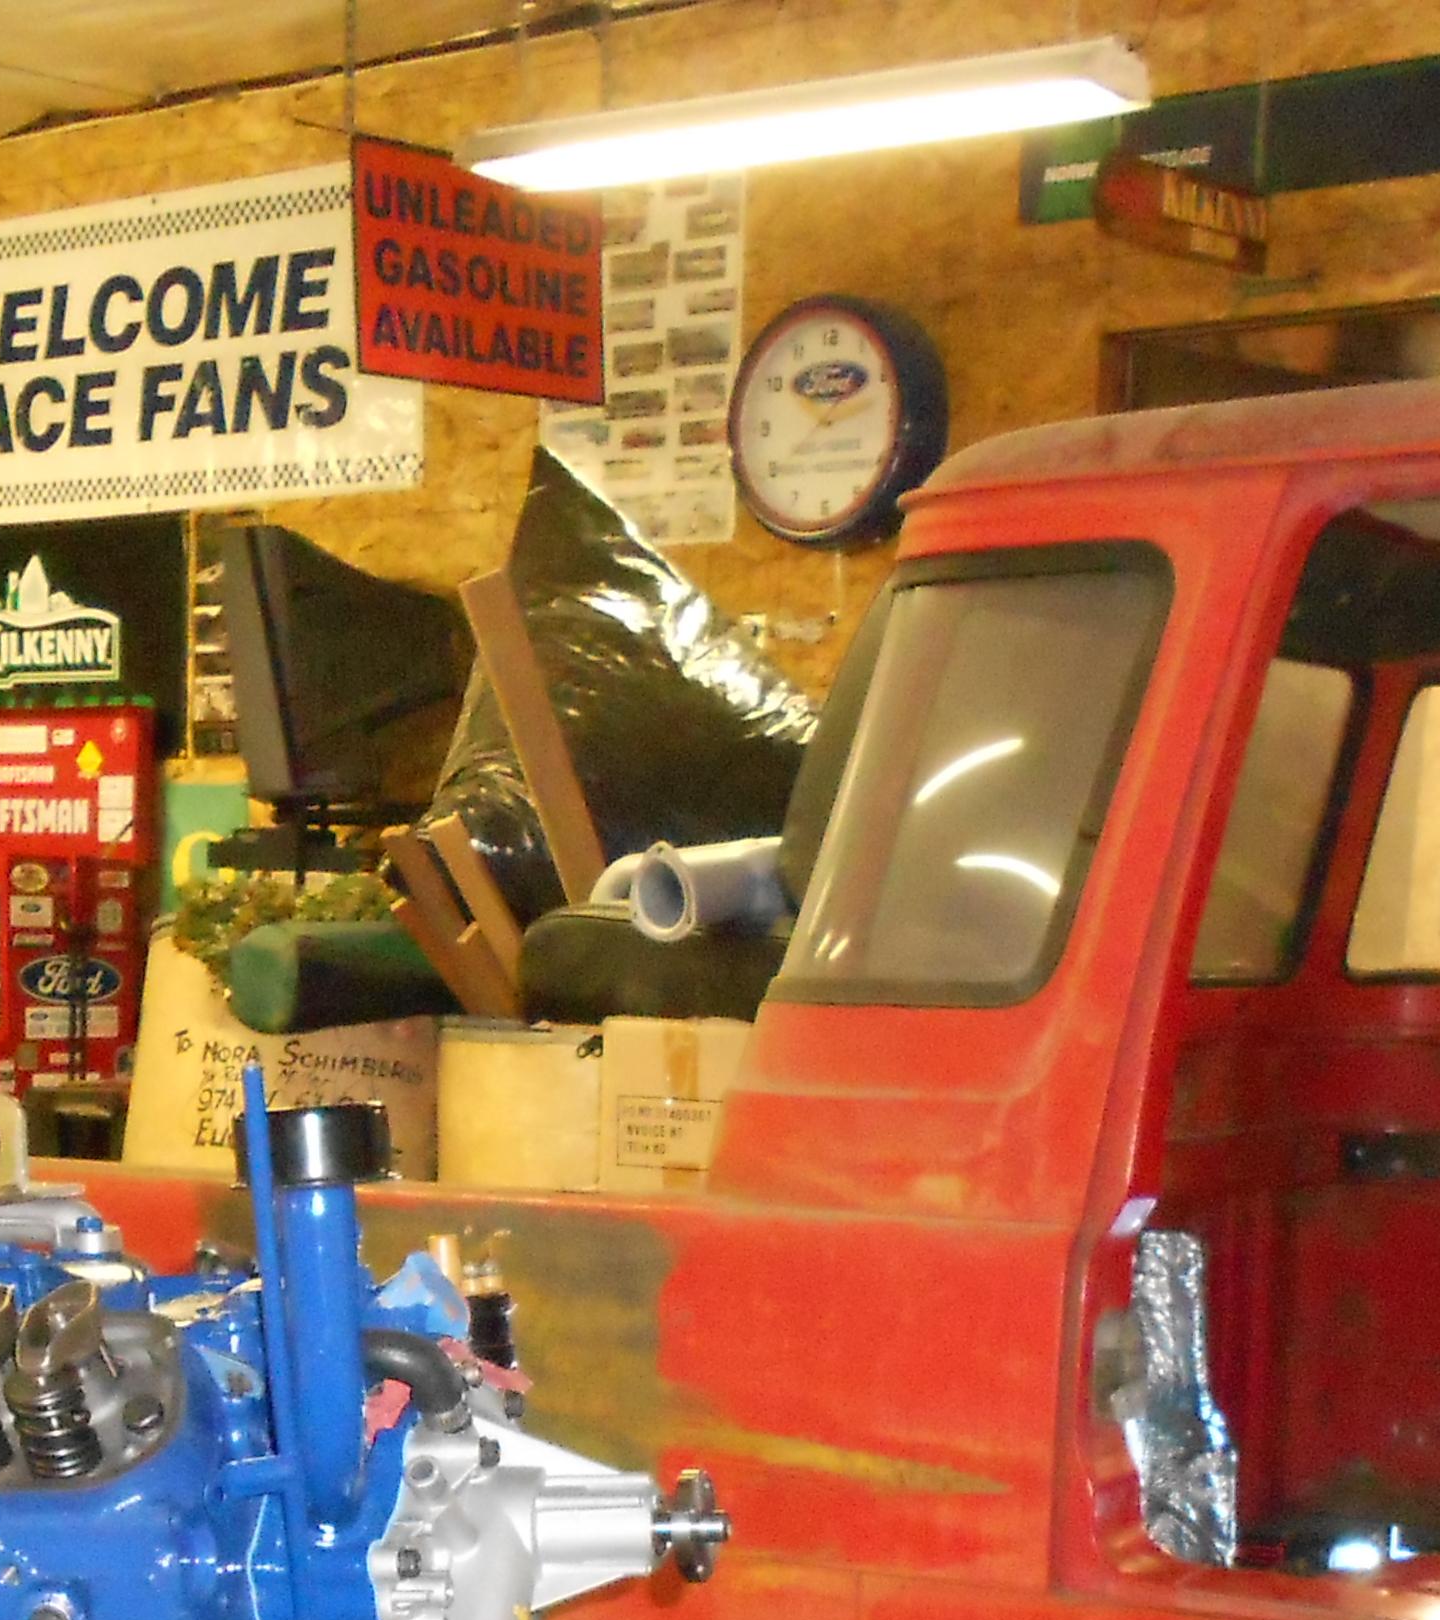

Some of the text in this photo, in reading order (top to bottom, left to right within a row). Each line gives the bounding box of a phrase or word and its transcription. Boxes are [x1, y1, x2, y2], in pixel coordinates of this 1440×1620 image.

[363, 173, 592, 257] UNLEADED
[374, 236, 588, 318] GASOLINE
[372, 303, 590, 379] AVAILABLE
[137, 345, 350, 442] FANS
